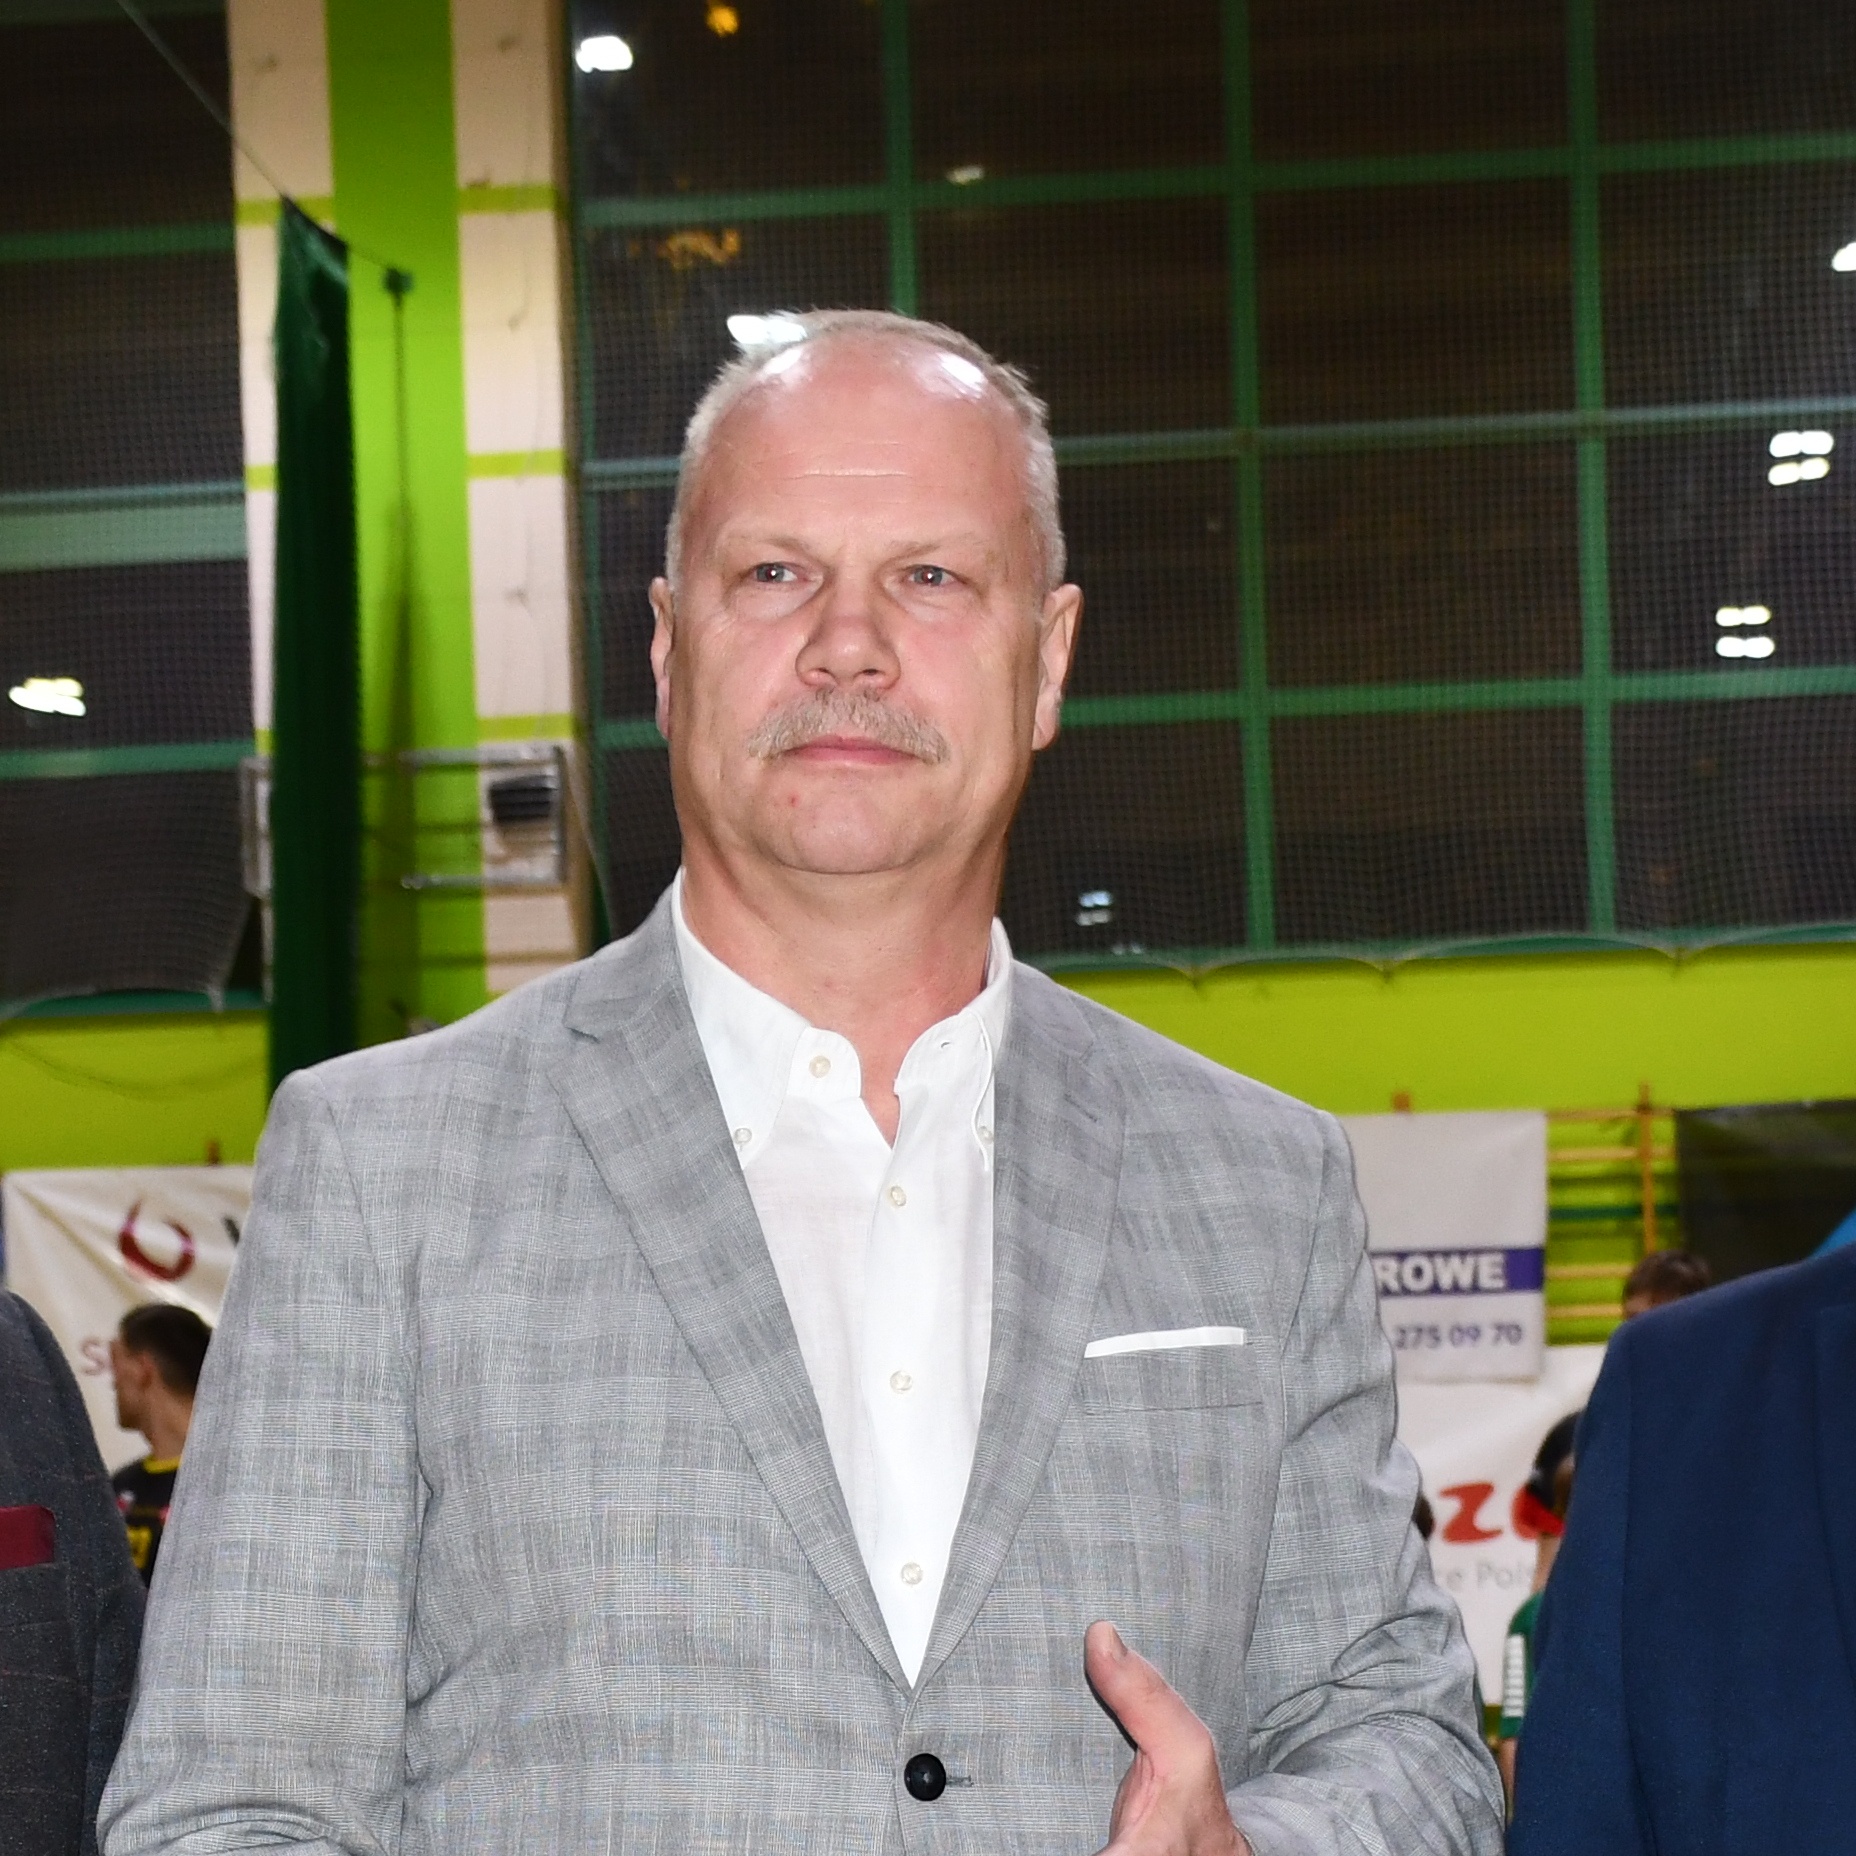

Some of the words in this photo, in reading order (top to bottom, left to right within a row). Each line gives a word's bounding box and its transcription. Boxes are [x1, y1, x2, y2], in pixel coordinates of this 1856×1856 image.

[1374, 1252, 1507, 1293] ROWE
[1395, 1323, 1441, 1349] 275
[1449, 1323, 1482, 1347] 09
